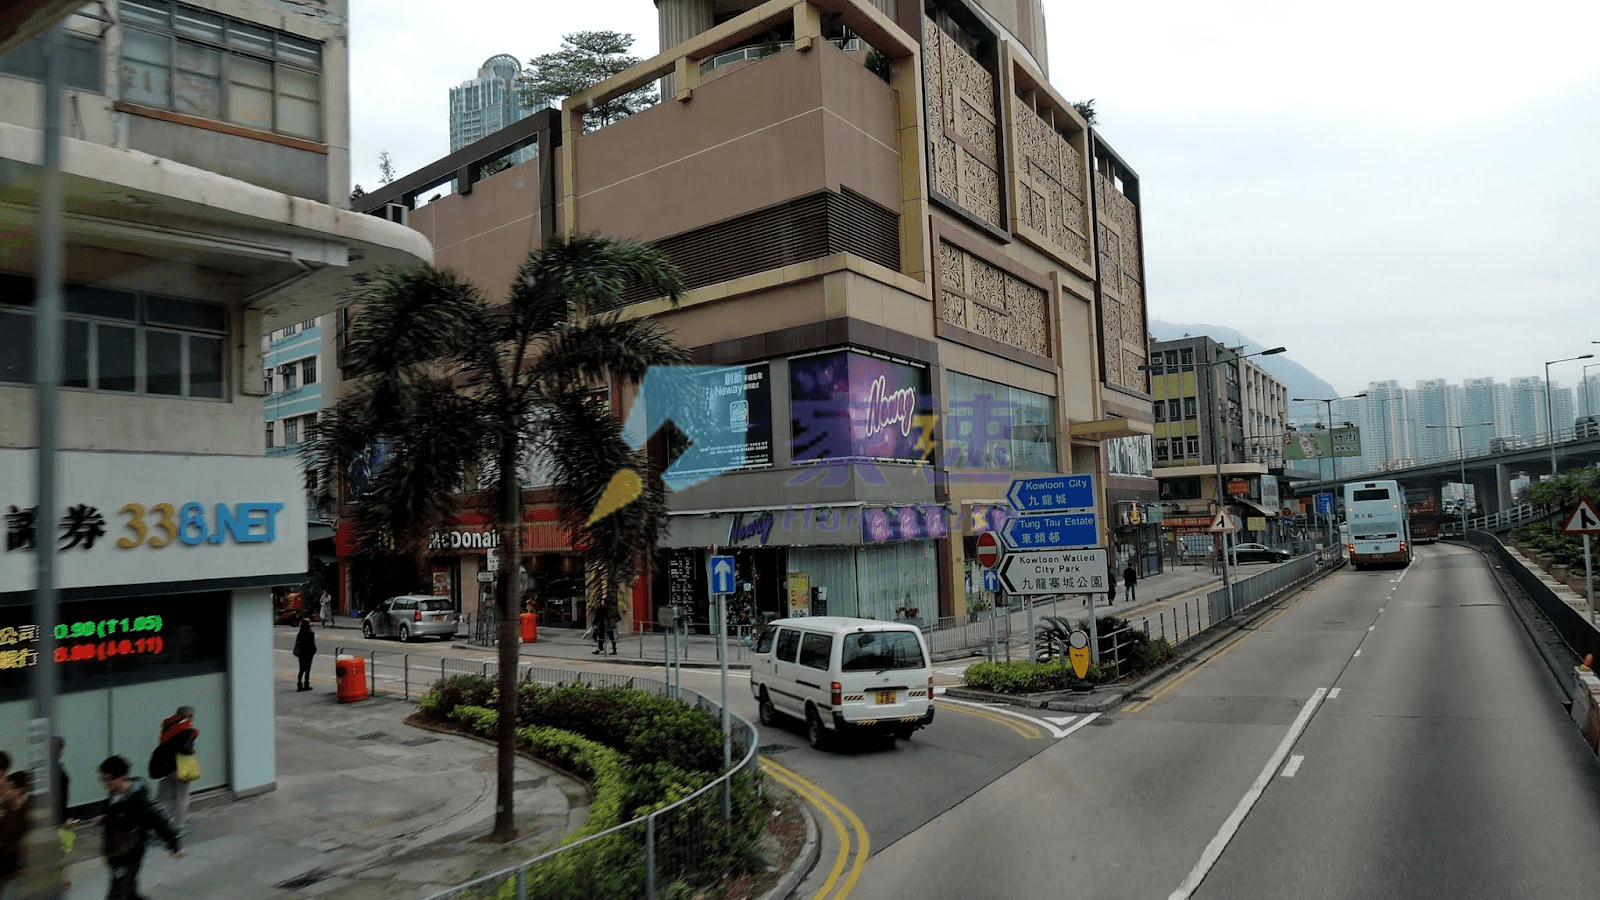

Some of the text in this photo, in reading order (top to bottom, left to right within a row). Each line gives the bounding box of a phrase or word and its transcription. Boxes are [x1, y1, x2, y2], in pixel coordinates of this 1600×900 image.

[715, 384, 743, 396] Neway
[866, 375, 915, 436] Neway
[1026, 479, 1087, 490] Kowloon City
[1028, 493, 1067, 507] 九龍城
[116, 502, 285, 549] 338.NET
[1020, 517, 1094, 530] Tung Tau Estate
[1021, 531, 1060, 544] 東頭邨
[1020, 554, 1095, 564] Kowloon Walled
[1035, 564, 1080, 574] City Park
[1022, 575, 1103, 590] 九龍寨城公園
